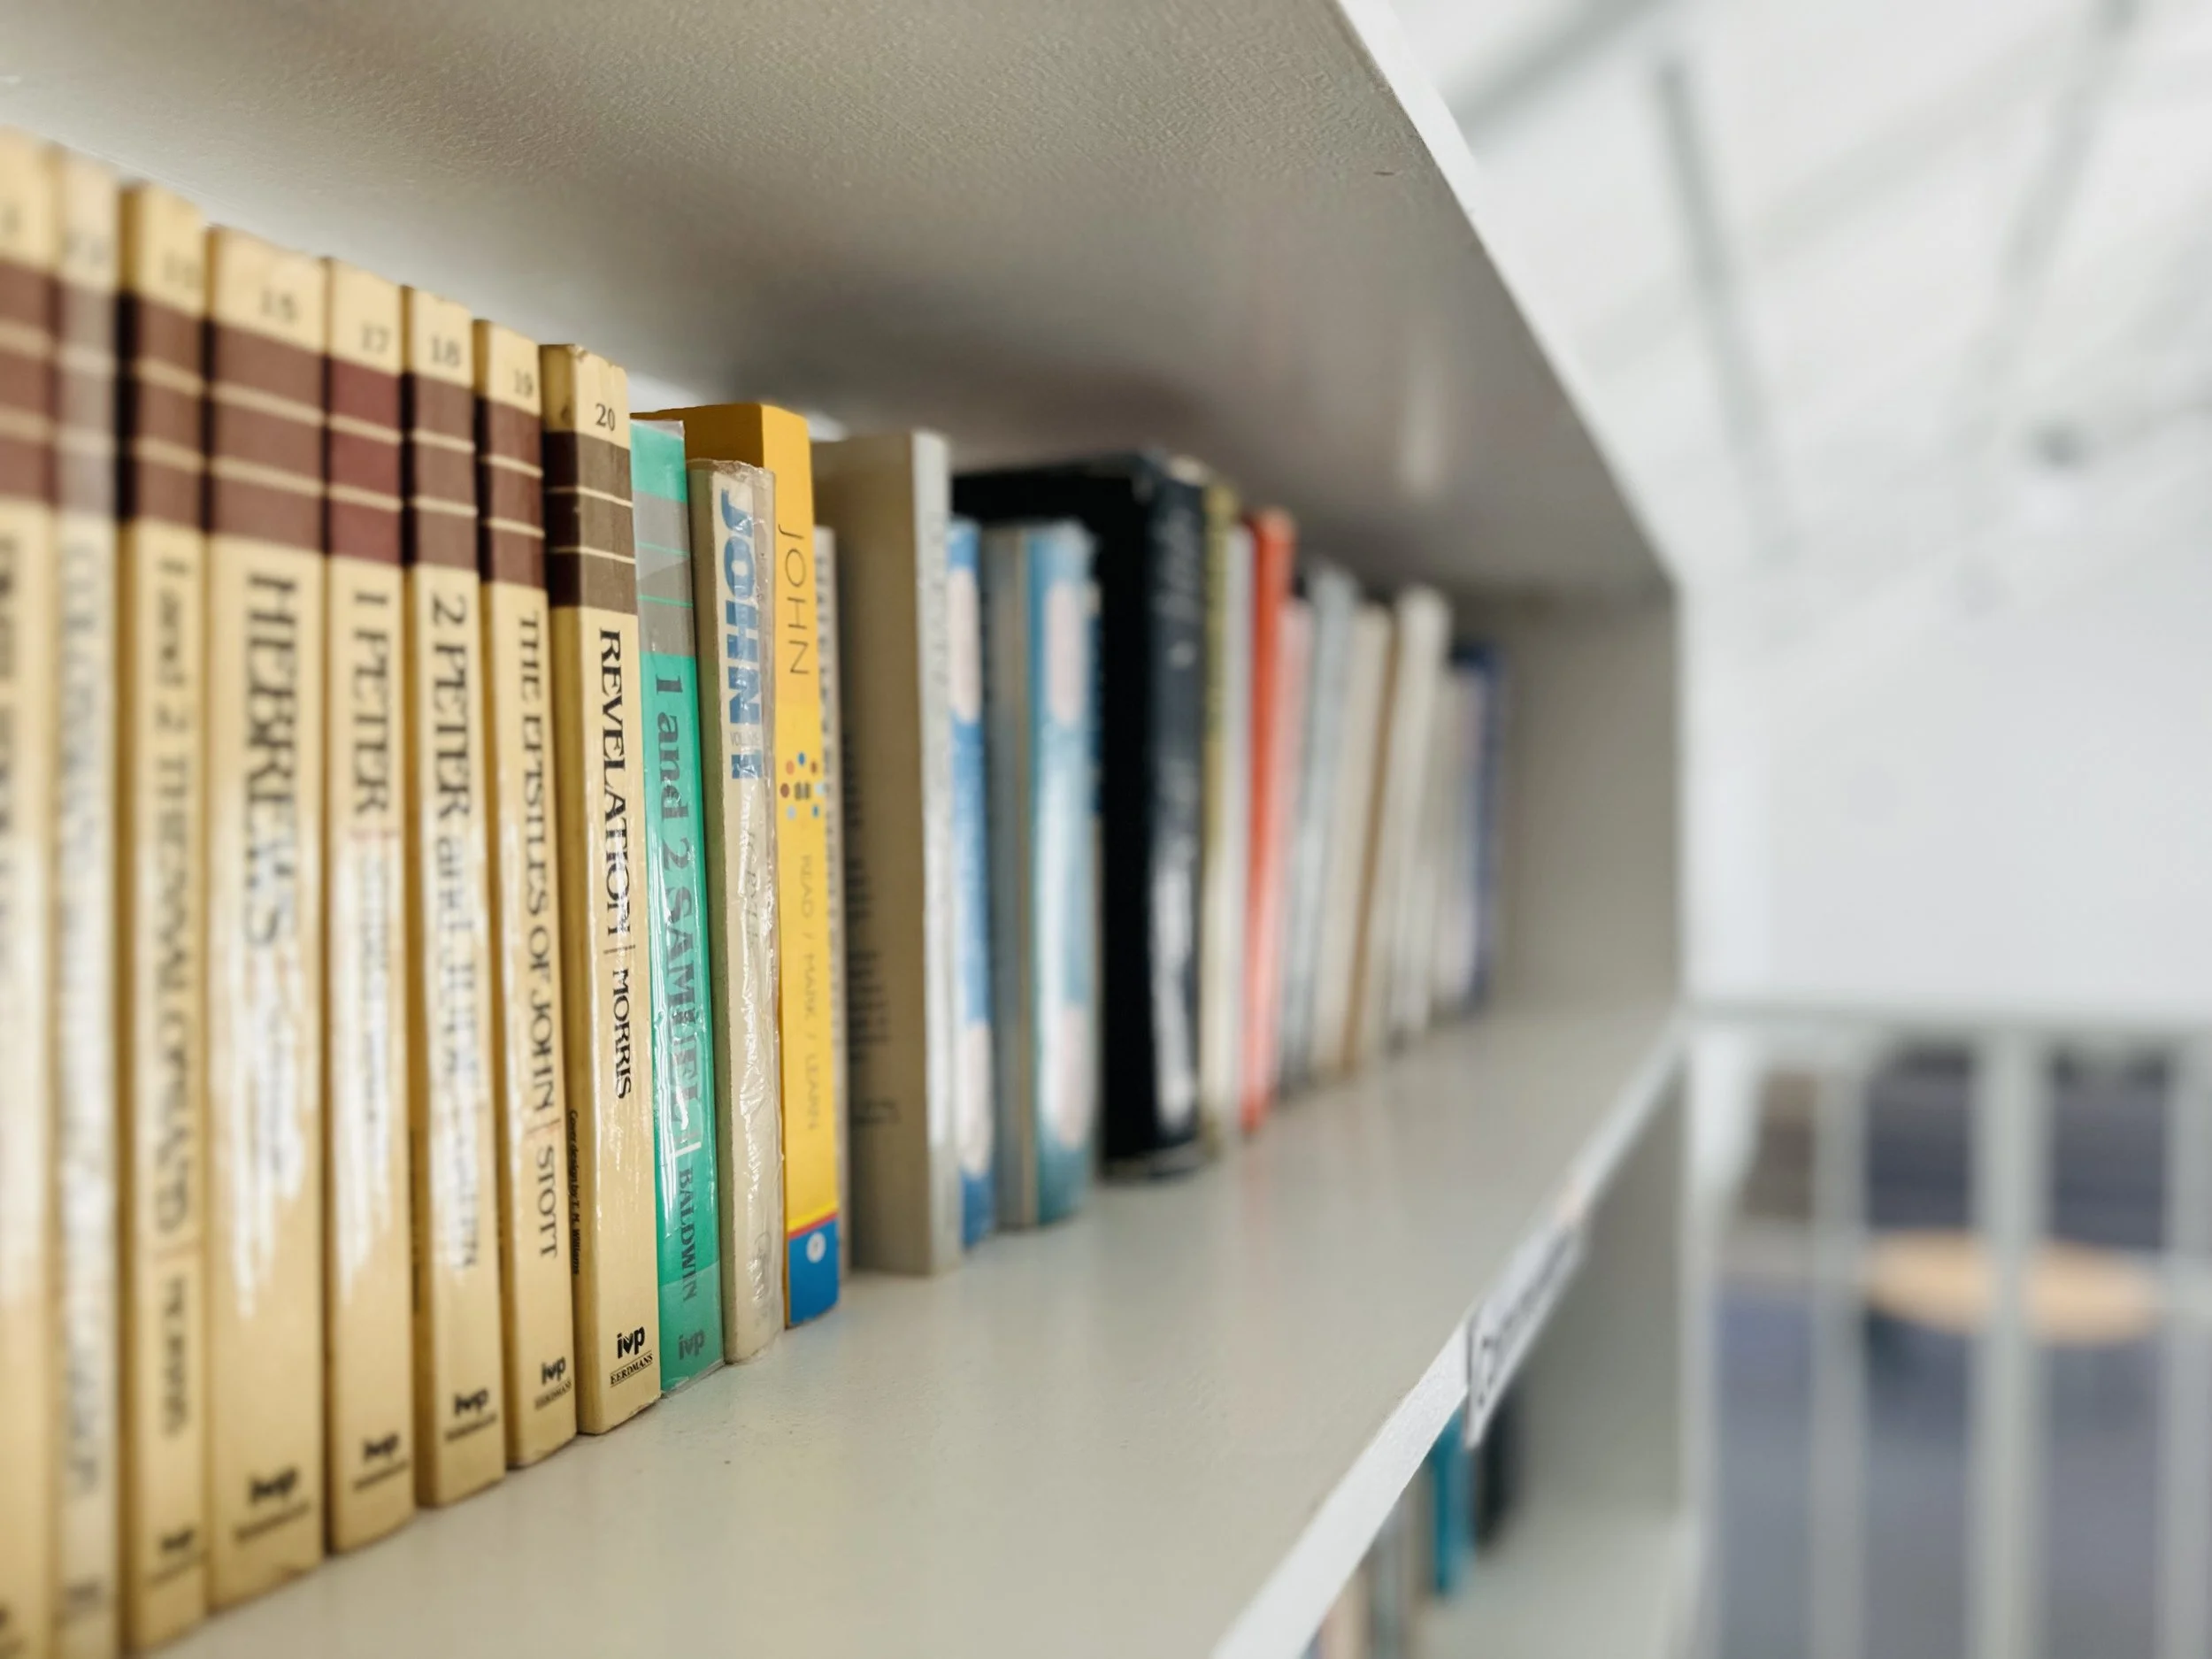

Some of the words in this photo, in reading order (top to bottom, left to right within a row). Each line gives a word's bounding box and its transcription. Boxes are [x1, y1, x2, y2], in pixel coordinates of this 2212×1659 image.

[361, 322, 391, 354] 17
[429, 336, 462, 370] 18
[513, 365, 534, 399] 19
[595, 403, 616, 432] 20
[431, 593, 467, 628] 2
[721, 490, 761, 724] JOHN
[779, 524, 810, 676] JOHN
[520, 614, 541, 703] THE
[354, 626, 391, 818] PETER
[434, 641, 471, 818] PETER
[598, 627, 630, 936] REVELATION
[657, 713, 692, 819] and
[523, 717, 549, 917] EPISTLES
[662, 837, 690, 872] 2
[800, 853, 816, 920] READ
[528, 926, 552, 989] OF
[800, 954, 819, 1025] MARK
[611, 968, 632, 1101] MORRIS
[664, 887, 699, 1122] SAMUEL
[531, 987, 555, 1115] JOHN
[568, 1108, 580, 1143] Cover
[803, 1053, 819, 1131] LEARN
[570, 1145, 580, 1184] design
[536, 1143, 559, 1260] STOTT
[678, 1168, 699, 1303] BALDWIN
[572, 1228, 581, 1276] Williams
[541, 1354, 566, 1385] ivp
[610, 1354, 653, 1386] EERDMANS
[616, 1325, 646, 1358] ivp
[678, 1329, 706, 1363] ivp
